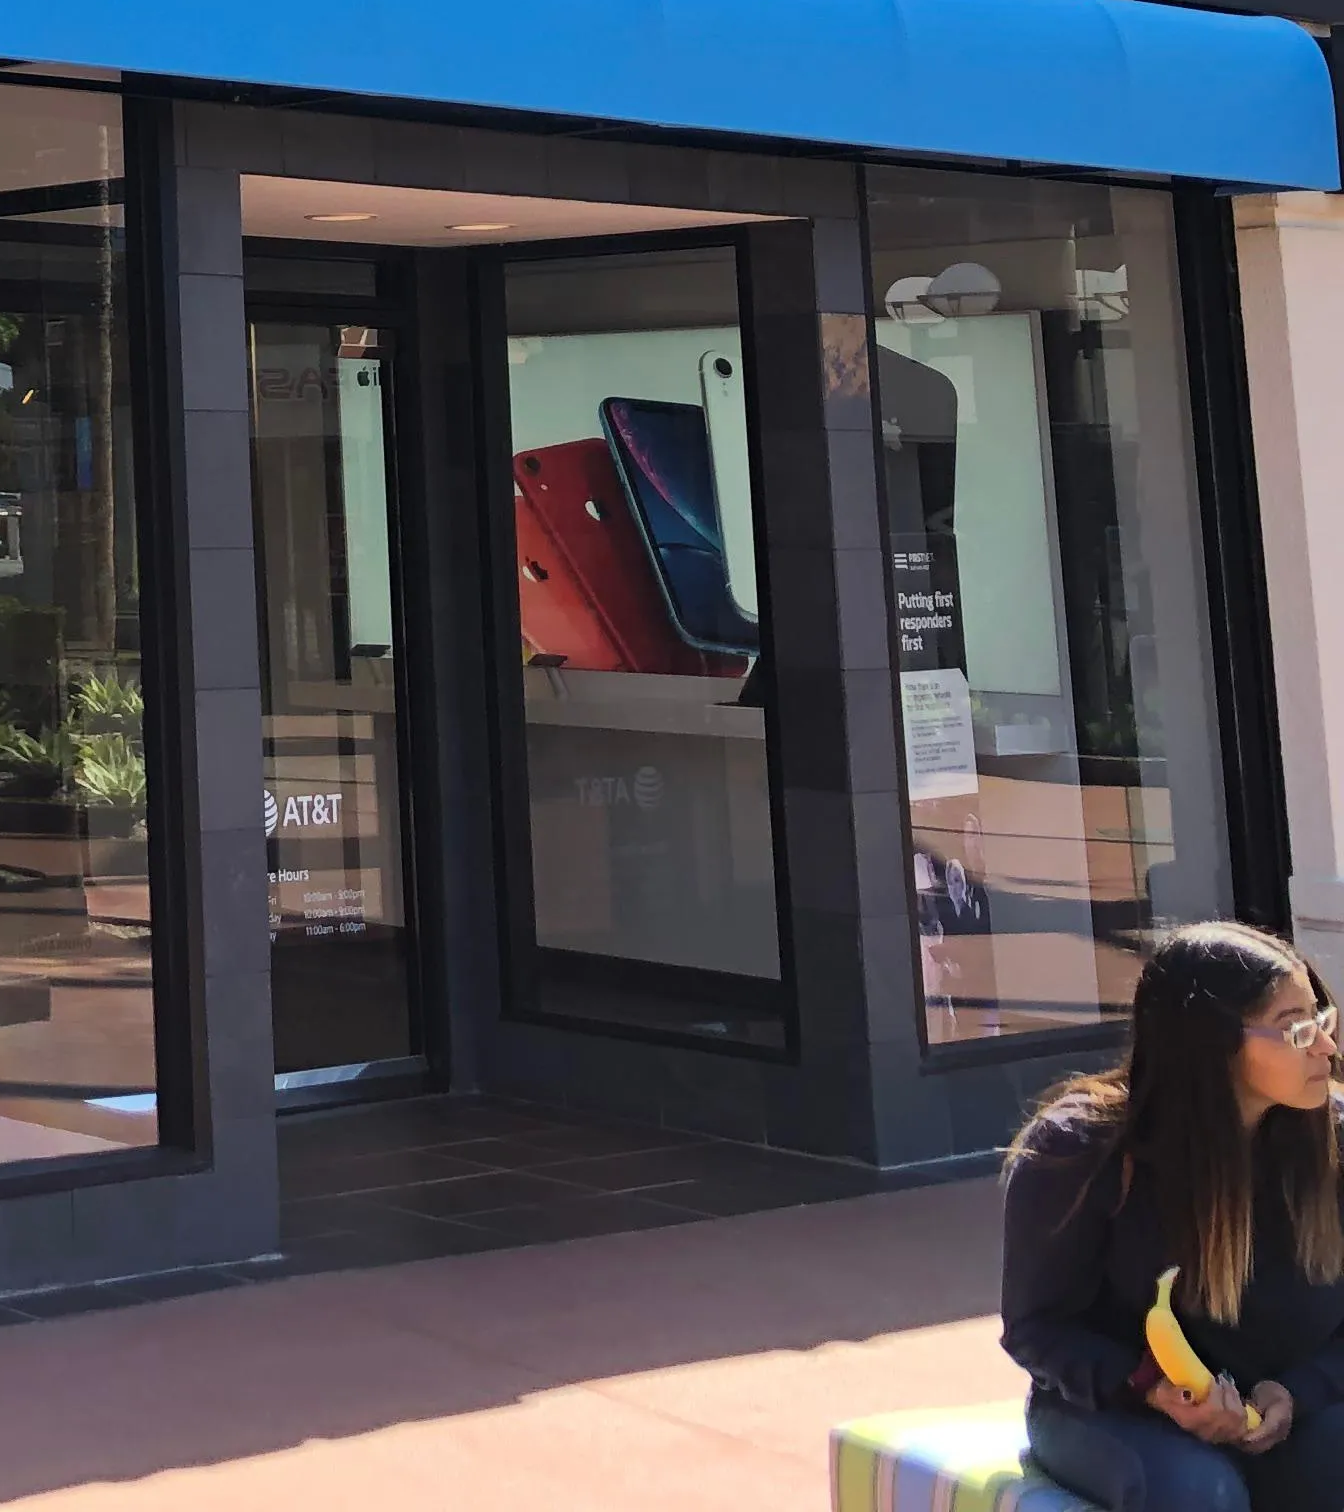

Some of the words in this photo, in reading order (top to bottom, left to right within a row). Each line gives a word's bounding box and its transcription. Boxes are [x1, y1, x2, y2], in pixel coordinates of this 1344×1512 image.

[898, 592, 934, 611] Putting
[935, 590, 954, 607] first
[900, 612, 952, 632] responders
[901, 634, 923, 651] first
[282, 793, 342, 827] AT&T
[278, 869, 309, 883] Hours
